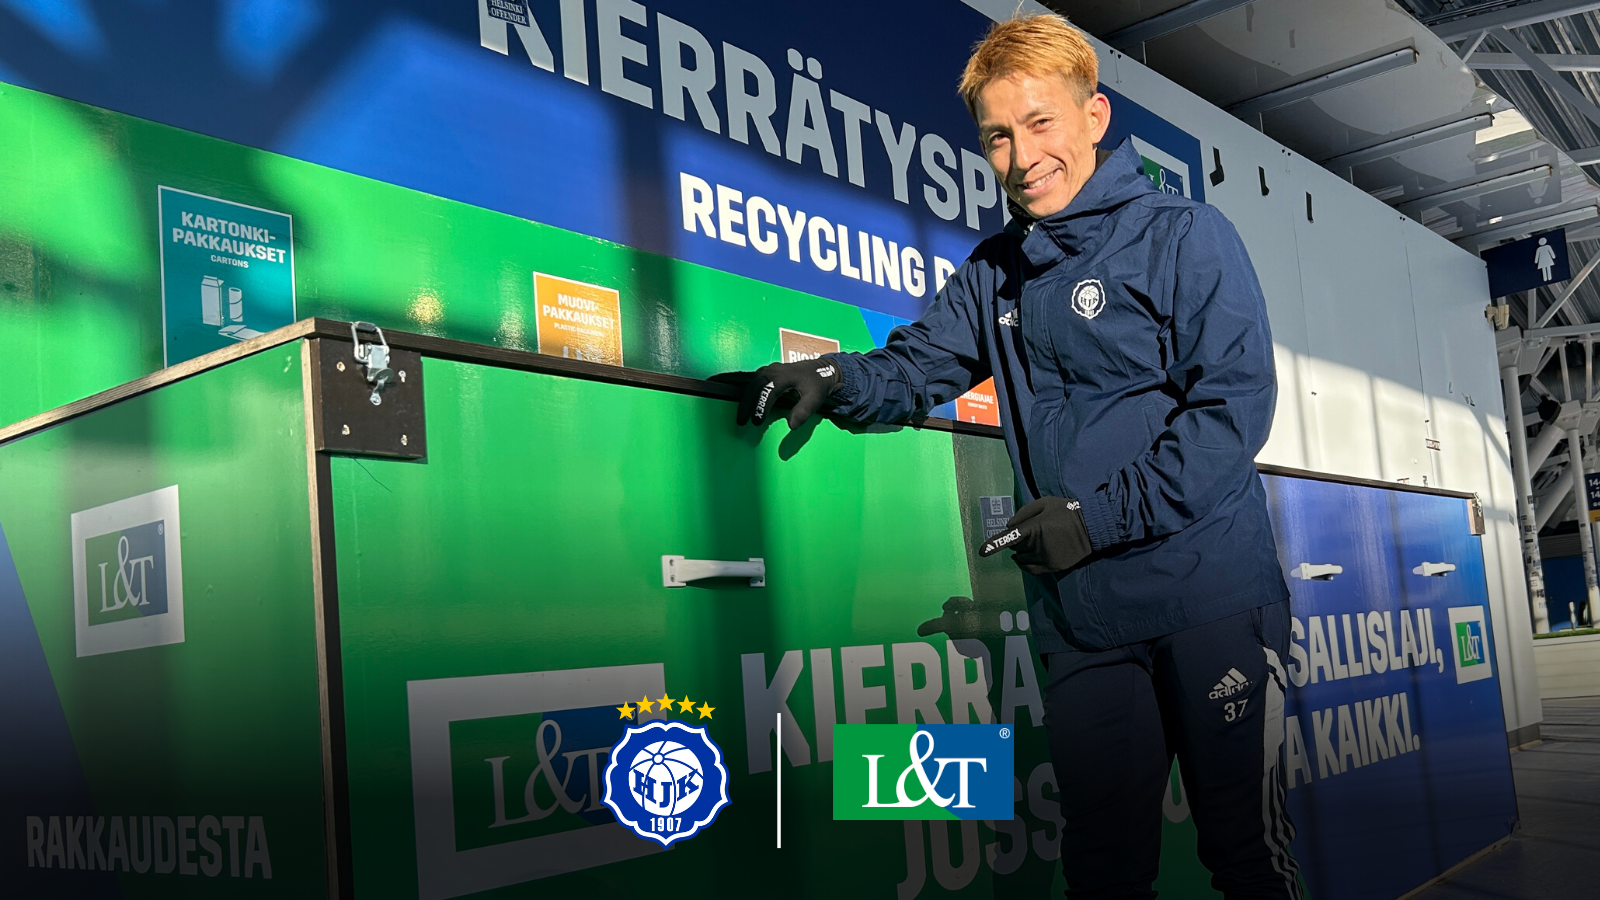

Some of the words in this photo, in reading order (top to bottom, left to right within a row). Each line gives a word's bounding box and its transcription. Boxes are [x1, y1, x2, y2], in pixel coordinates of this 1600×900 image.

[491, 0, 523, 14] HELSINKI
[491, 7, 527, 25] OFFENDER
[181, 211, 276, 244] KARTONKI-
[680, 171, 926, 298] RECYCLING
[172, 227, 286, 264] PAKKAUKSET
[210, 254, 249, 269] CARTONS
[542, 304, 616, 330] PAKKAUKSET
[557, 293, 600, 313] MUOVI-
[755, 387, 773, 419] TERREX
[993, 528, 1021, 548] TERREX
[98, 536, 154, 612] L&T
[1461, 624, 1480, 662] L&T
[1224, 698, 1248, 722] 37
[1311, 692, 1421, 779] KAIKKI.
[26, 815, 272, 879] RAKKAUDESTA
